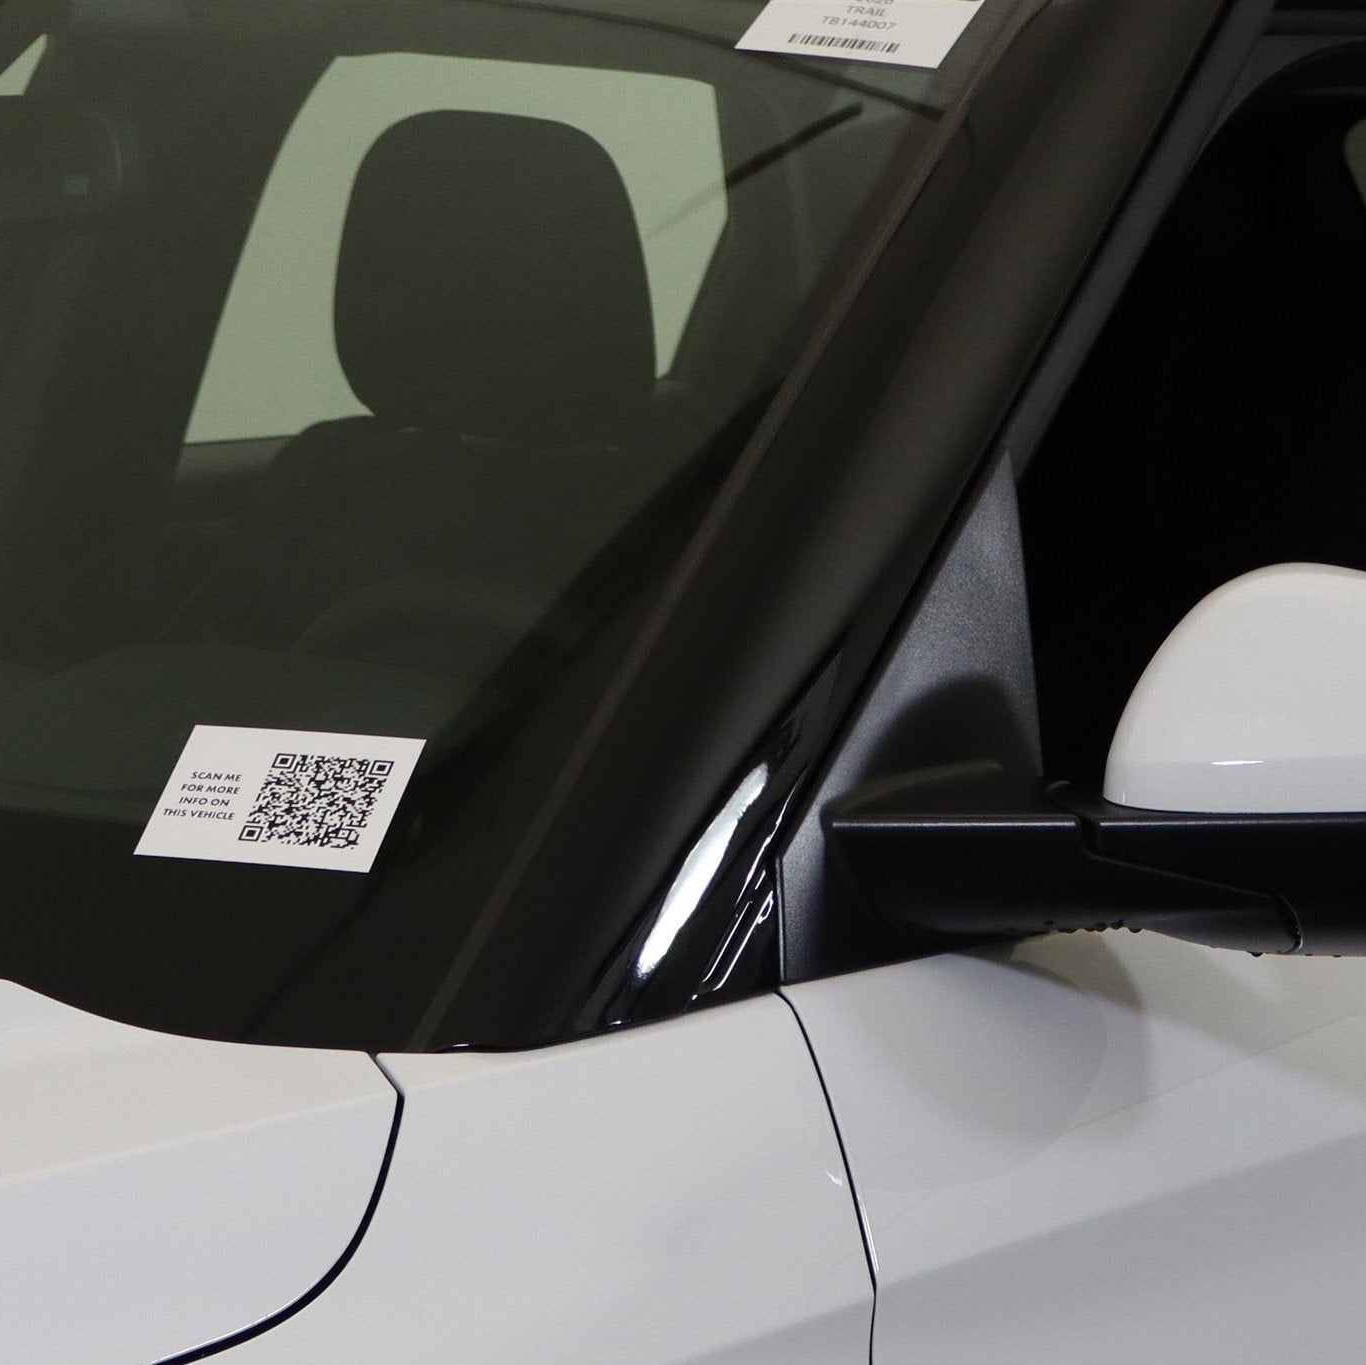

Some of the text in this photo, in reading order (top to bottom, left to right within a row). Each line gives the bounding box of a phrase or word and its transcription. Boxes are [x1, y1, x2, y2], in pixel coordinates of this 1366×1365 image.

[846, 5, 887, 17] TRAIL
[191, 771, 242, 782] SCAN ME
[180, 783, 241, 795] FOR MORE
[178, 796, 231, 807] INFO ON
[163, 808, 235, 821] THIS VEHICLE
